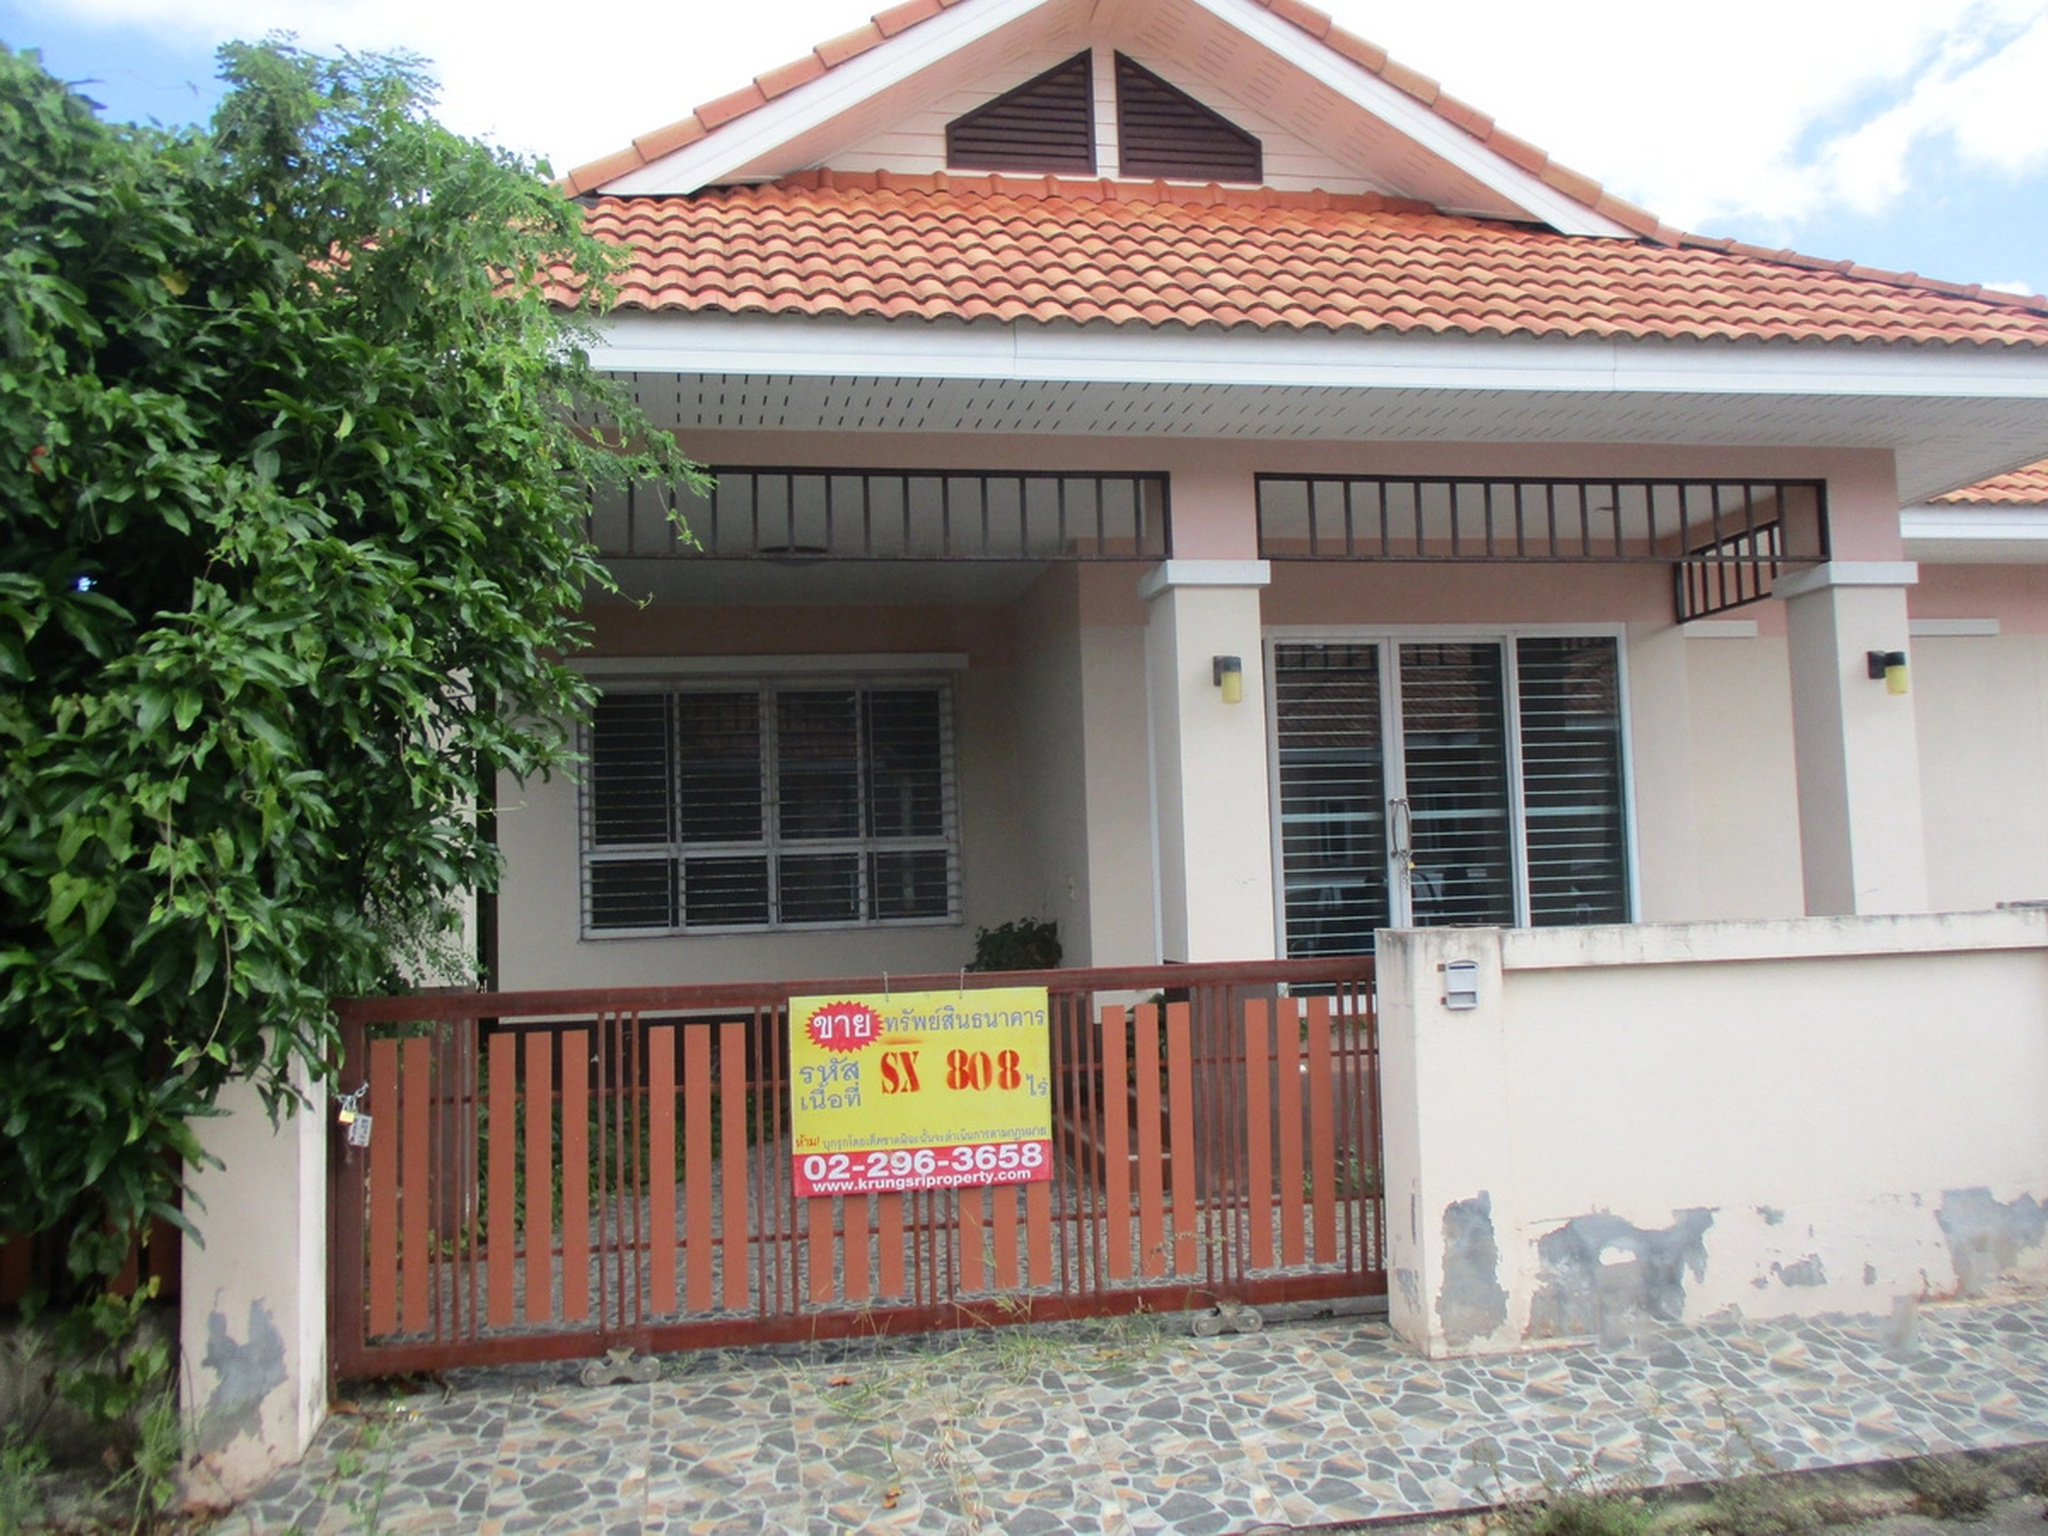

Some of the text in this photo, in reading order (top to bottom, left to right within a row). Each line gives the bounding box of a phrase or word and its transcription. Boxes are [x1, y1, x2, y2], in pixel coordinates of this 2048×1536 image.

[813, 1004, 1046, 1039] ขาย ทรัพย์สินธนาคาร
[799, 1049, 1022, 1094] รหัส SX 808
[800, 1073, 1048, 1110] เนื้อที่ ไร่
[803, 1142, 1043, 1181] 02-296-3658
[812, 1169, 1031, 1192] www.krungsriproperty.com
